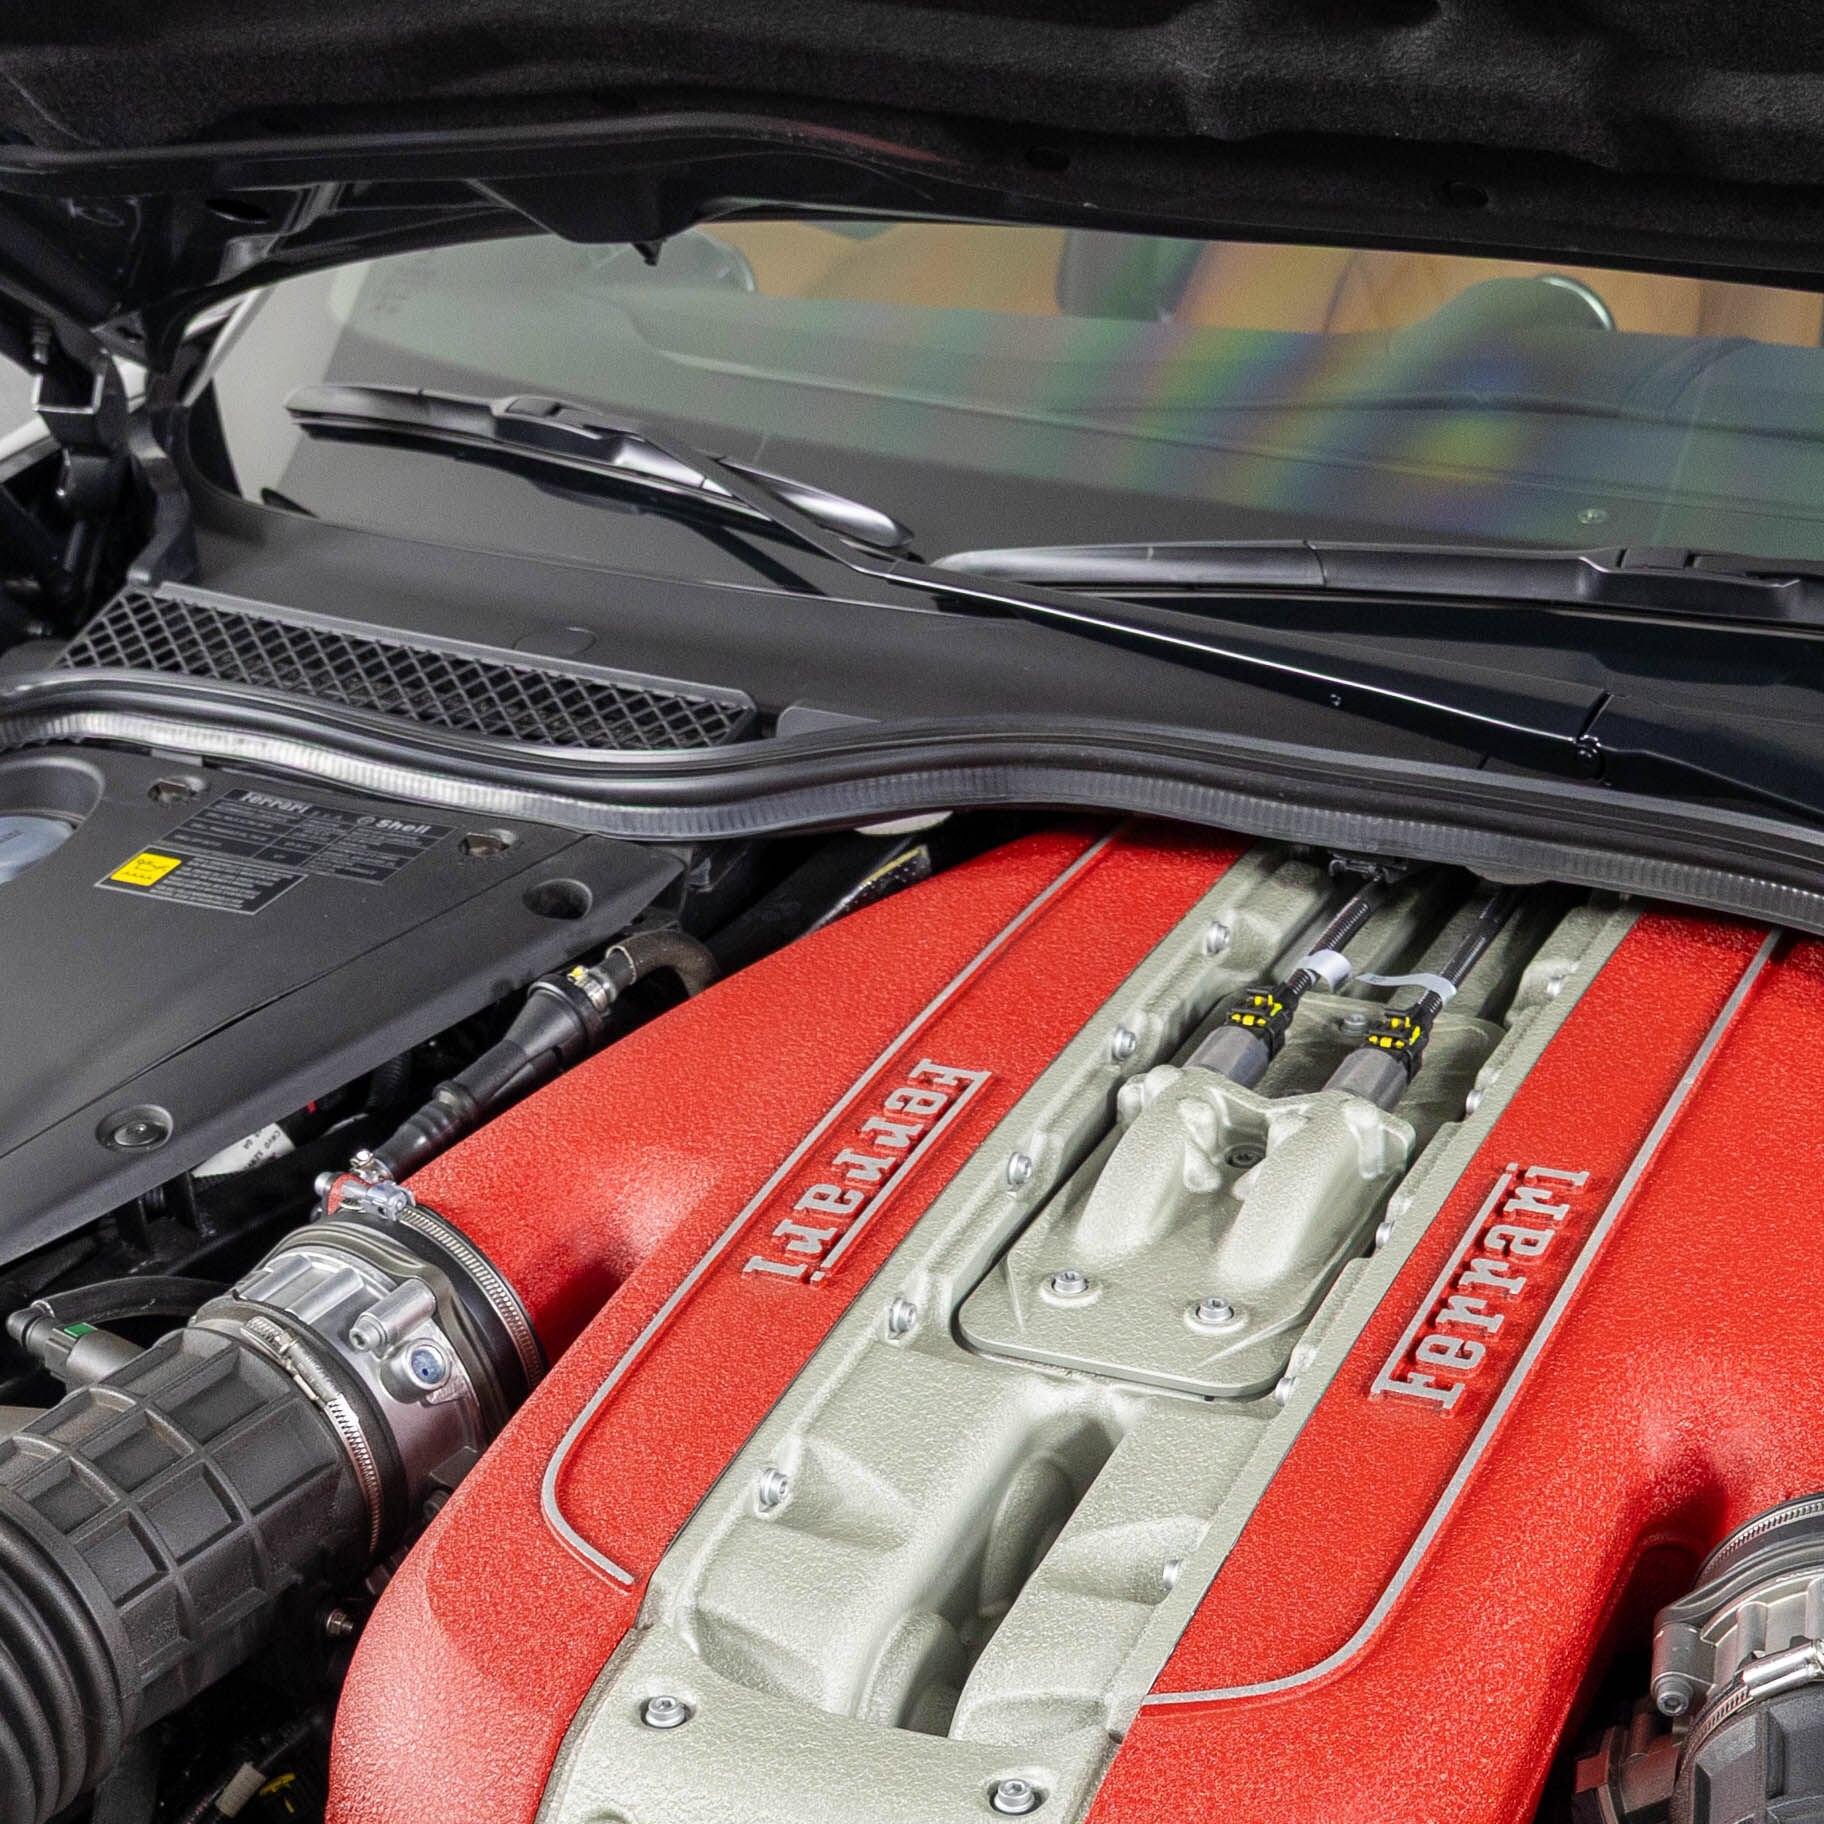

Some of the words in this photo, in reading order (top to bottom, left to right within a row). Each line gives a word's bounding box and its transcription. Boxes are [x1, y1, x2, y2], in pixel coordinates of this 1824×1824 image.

[240, 790, 309, 815] Ferrari
[375, 817, 433, 836] Shell
[743, 1058, 992, 1283] Ferrari
[1370, 1161, 1590, 1410] Ferrari
